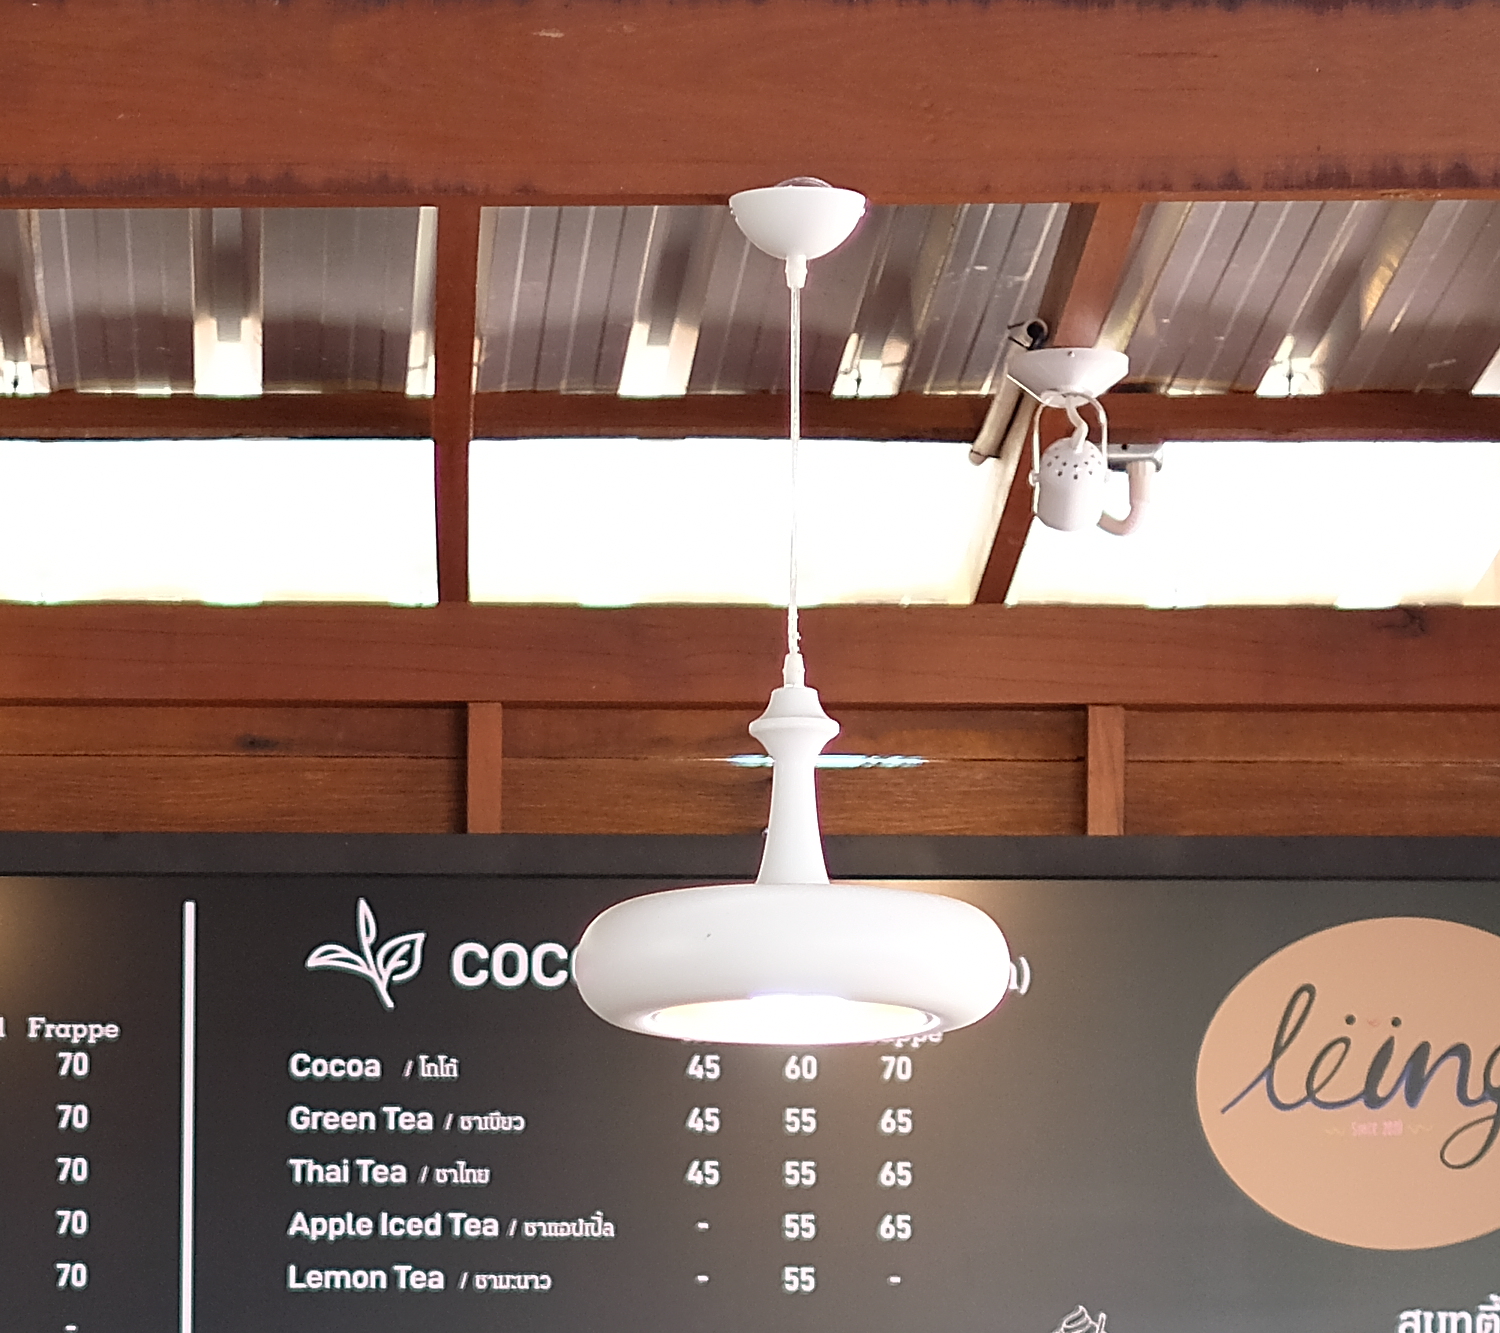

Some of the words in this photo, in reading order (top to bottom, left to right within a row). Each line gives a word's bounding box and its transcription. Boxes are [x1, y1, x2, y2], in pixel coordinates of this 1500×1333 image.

[452, 942, 579, 987] COC
[27, 1016, 119, 1044] Frappe
[58, 1051, 89, 1077] 70
[290, 1052, 381, 1078] Cocoa
[686, 1054, 721, 1080] 45
[784, 1054, 818, 1080] 60
[880, 1055, 912, 1081] 70
[56, 1104, 88, 1129] 70
[289, 1105, 376, 1131] Green
[381, 1106, 434, 1131] Tea
[686, 1107, 720, 1133] 45
[784, 1107, 817, 1133] 55
[880, 1108, 913, 1134] 65
[56, 1157, 88, 1182] 70
[288, 1158, 349, 1184] Thai
[355, 1159, 407, 1184] Tea
[434, 1160, 491, 1184] ชาไทย
[686, 1160, 720, 1186] 45
[784, 1160, 816, 1186] 55
[879, 1161, 912, 1187] 65
[56, 1209, 88, 1235] 70
[288, 1211, 374, 1241] Apple
[380, 1211, 442, 1237] Iced
[446, 1212, 499, 1237] Tea
[784, 1213, 816, 1239] 55
[879, 1214, 912, 1240] 65
[56, 1262, 87, 1288] 70
[288, 1264, 387, 1289] Lemon
[392, 1264, 445, 1290] Tea
[474, 1274, 552, 1290] ชามะนาว
[784, 1266, 816, 1292] 55
